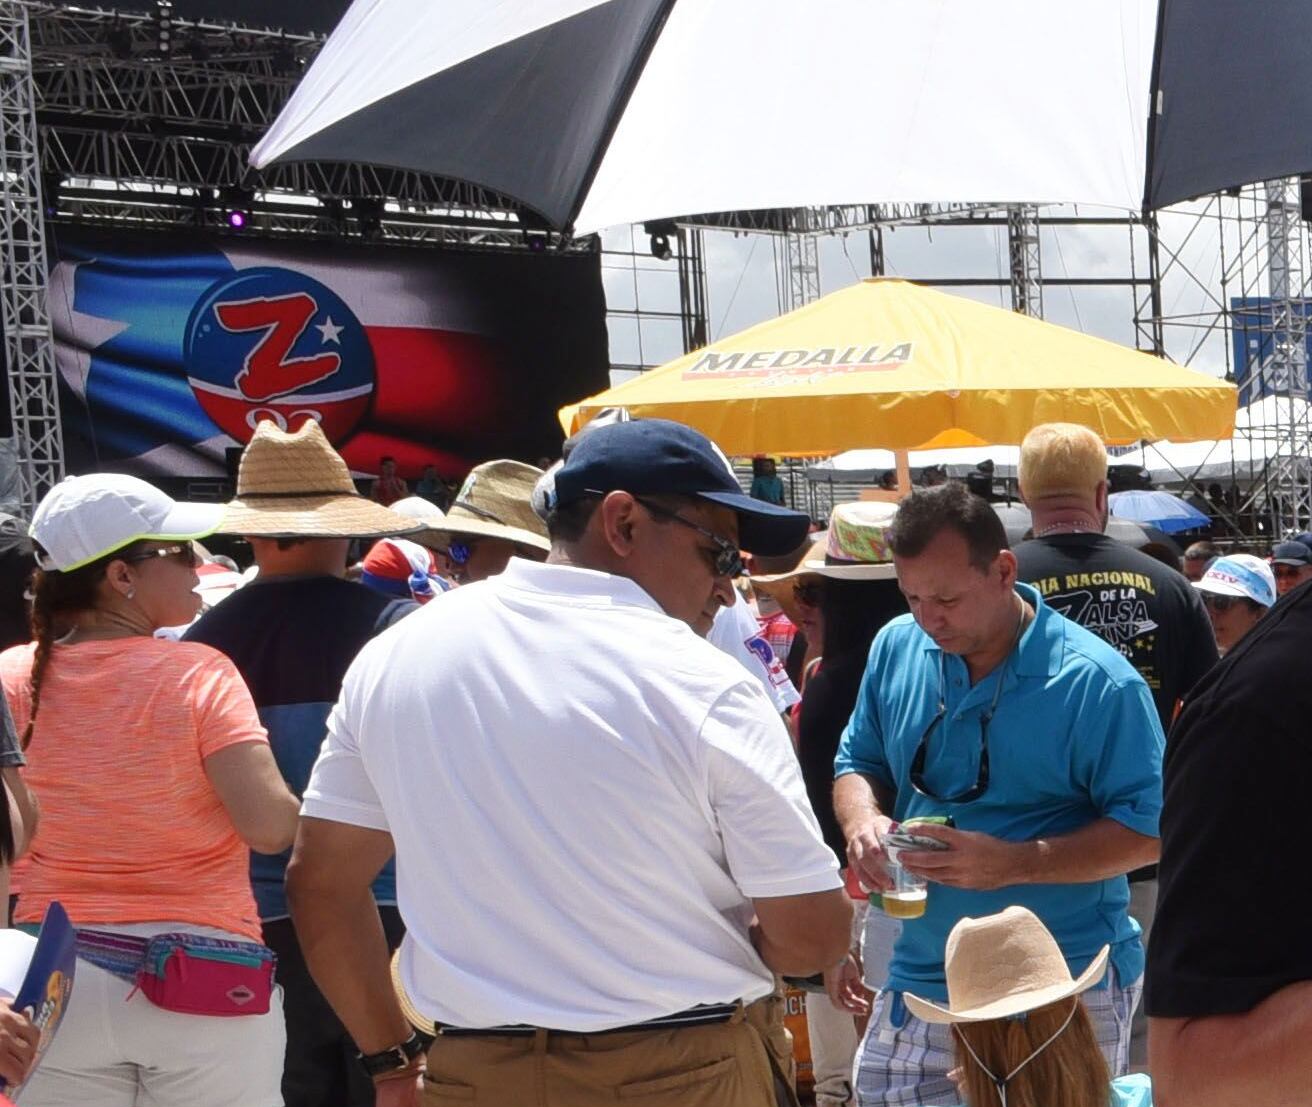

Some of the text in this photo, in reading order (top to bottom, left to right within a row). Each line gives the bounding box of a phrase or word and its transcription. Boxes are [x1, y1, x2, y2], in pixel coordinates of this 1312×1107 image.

[213, 291, 341, 402] Z
[691, 342, 913, 372] MEDALLA
[1065, 571, 1156, 596] NACIONAL
[1101, 588, 1137, 602] DE LA
